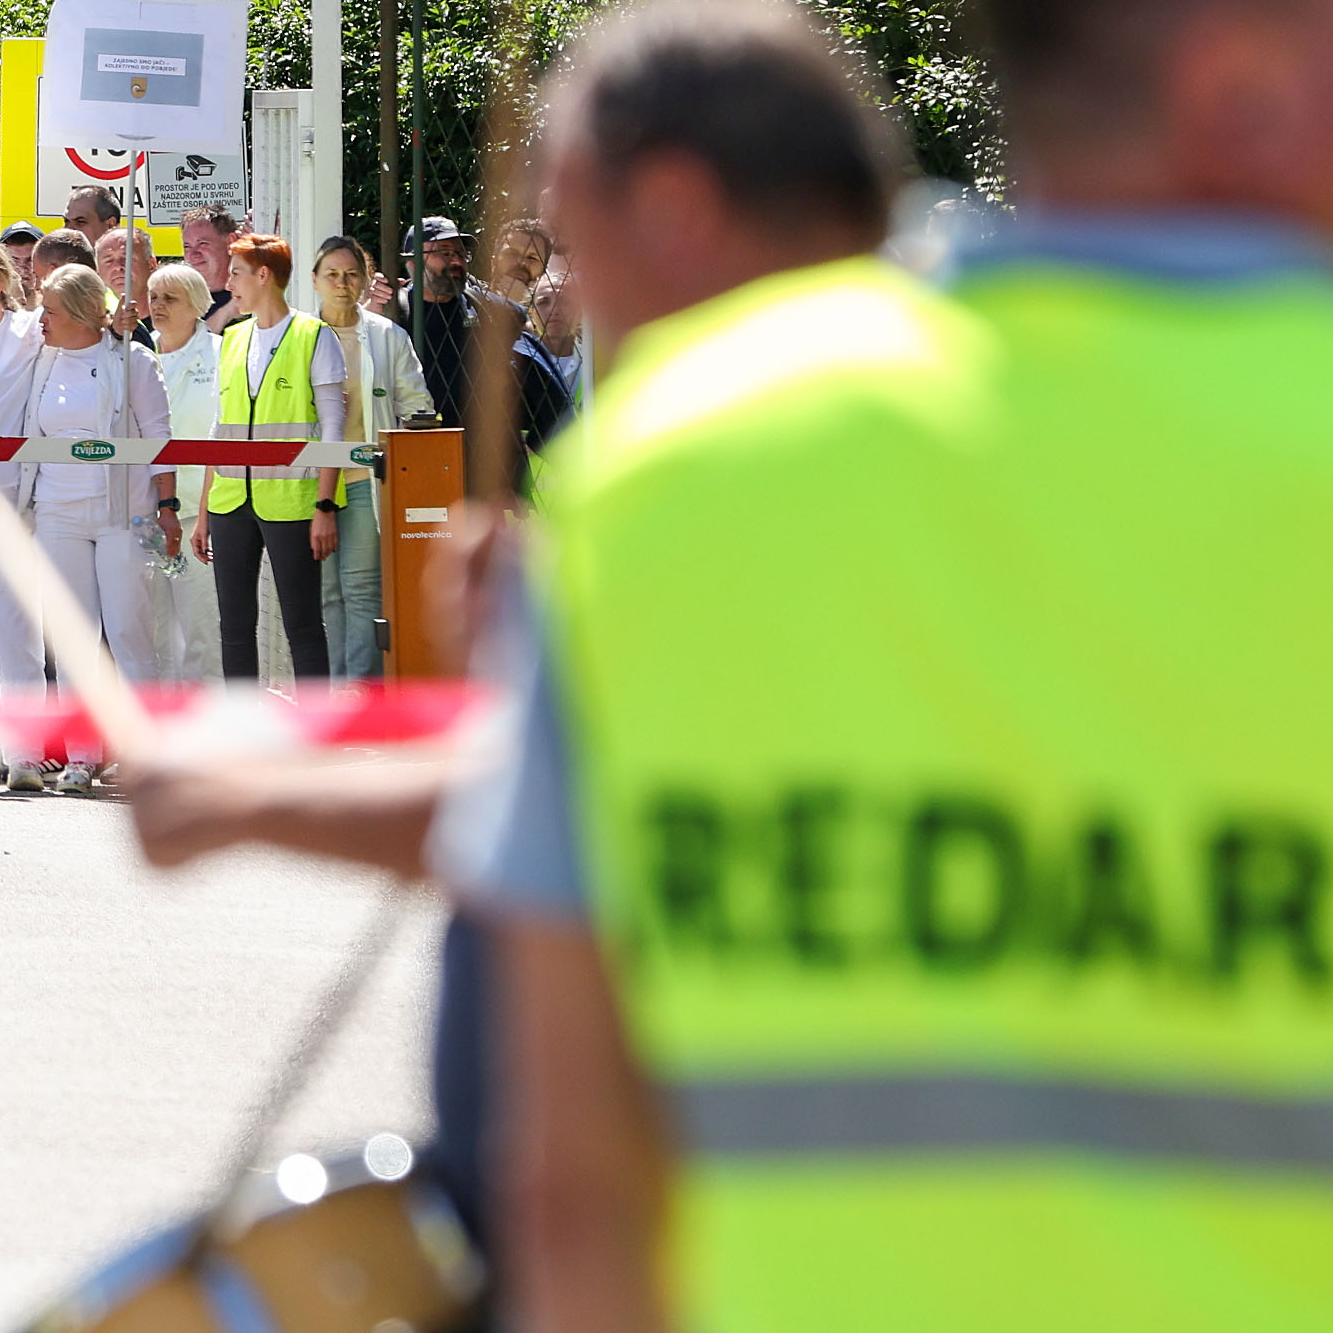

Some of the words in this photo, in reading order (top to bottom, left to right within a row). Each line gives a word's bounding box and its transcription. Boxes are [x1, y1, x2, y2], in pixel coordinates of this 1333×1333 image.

[155, 184, 189, 192] PROSTOR
[191, 183, 199, 191] JE
[217, 182, 240, 190] VIDEO
[161, 192, 201, 200] NADZOROM
[153, 200, 182, 209] ZAŠTITE
[74, 446, 112, 457] ZVIJEZDA
[401, 530, 453, 539] novotecnica
[639, 778, 1333, 988] REDAR
